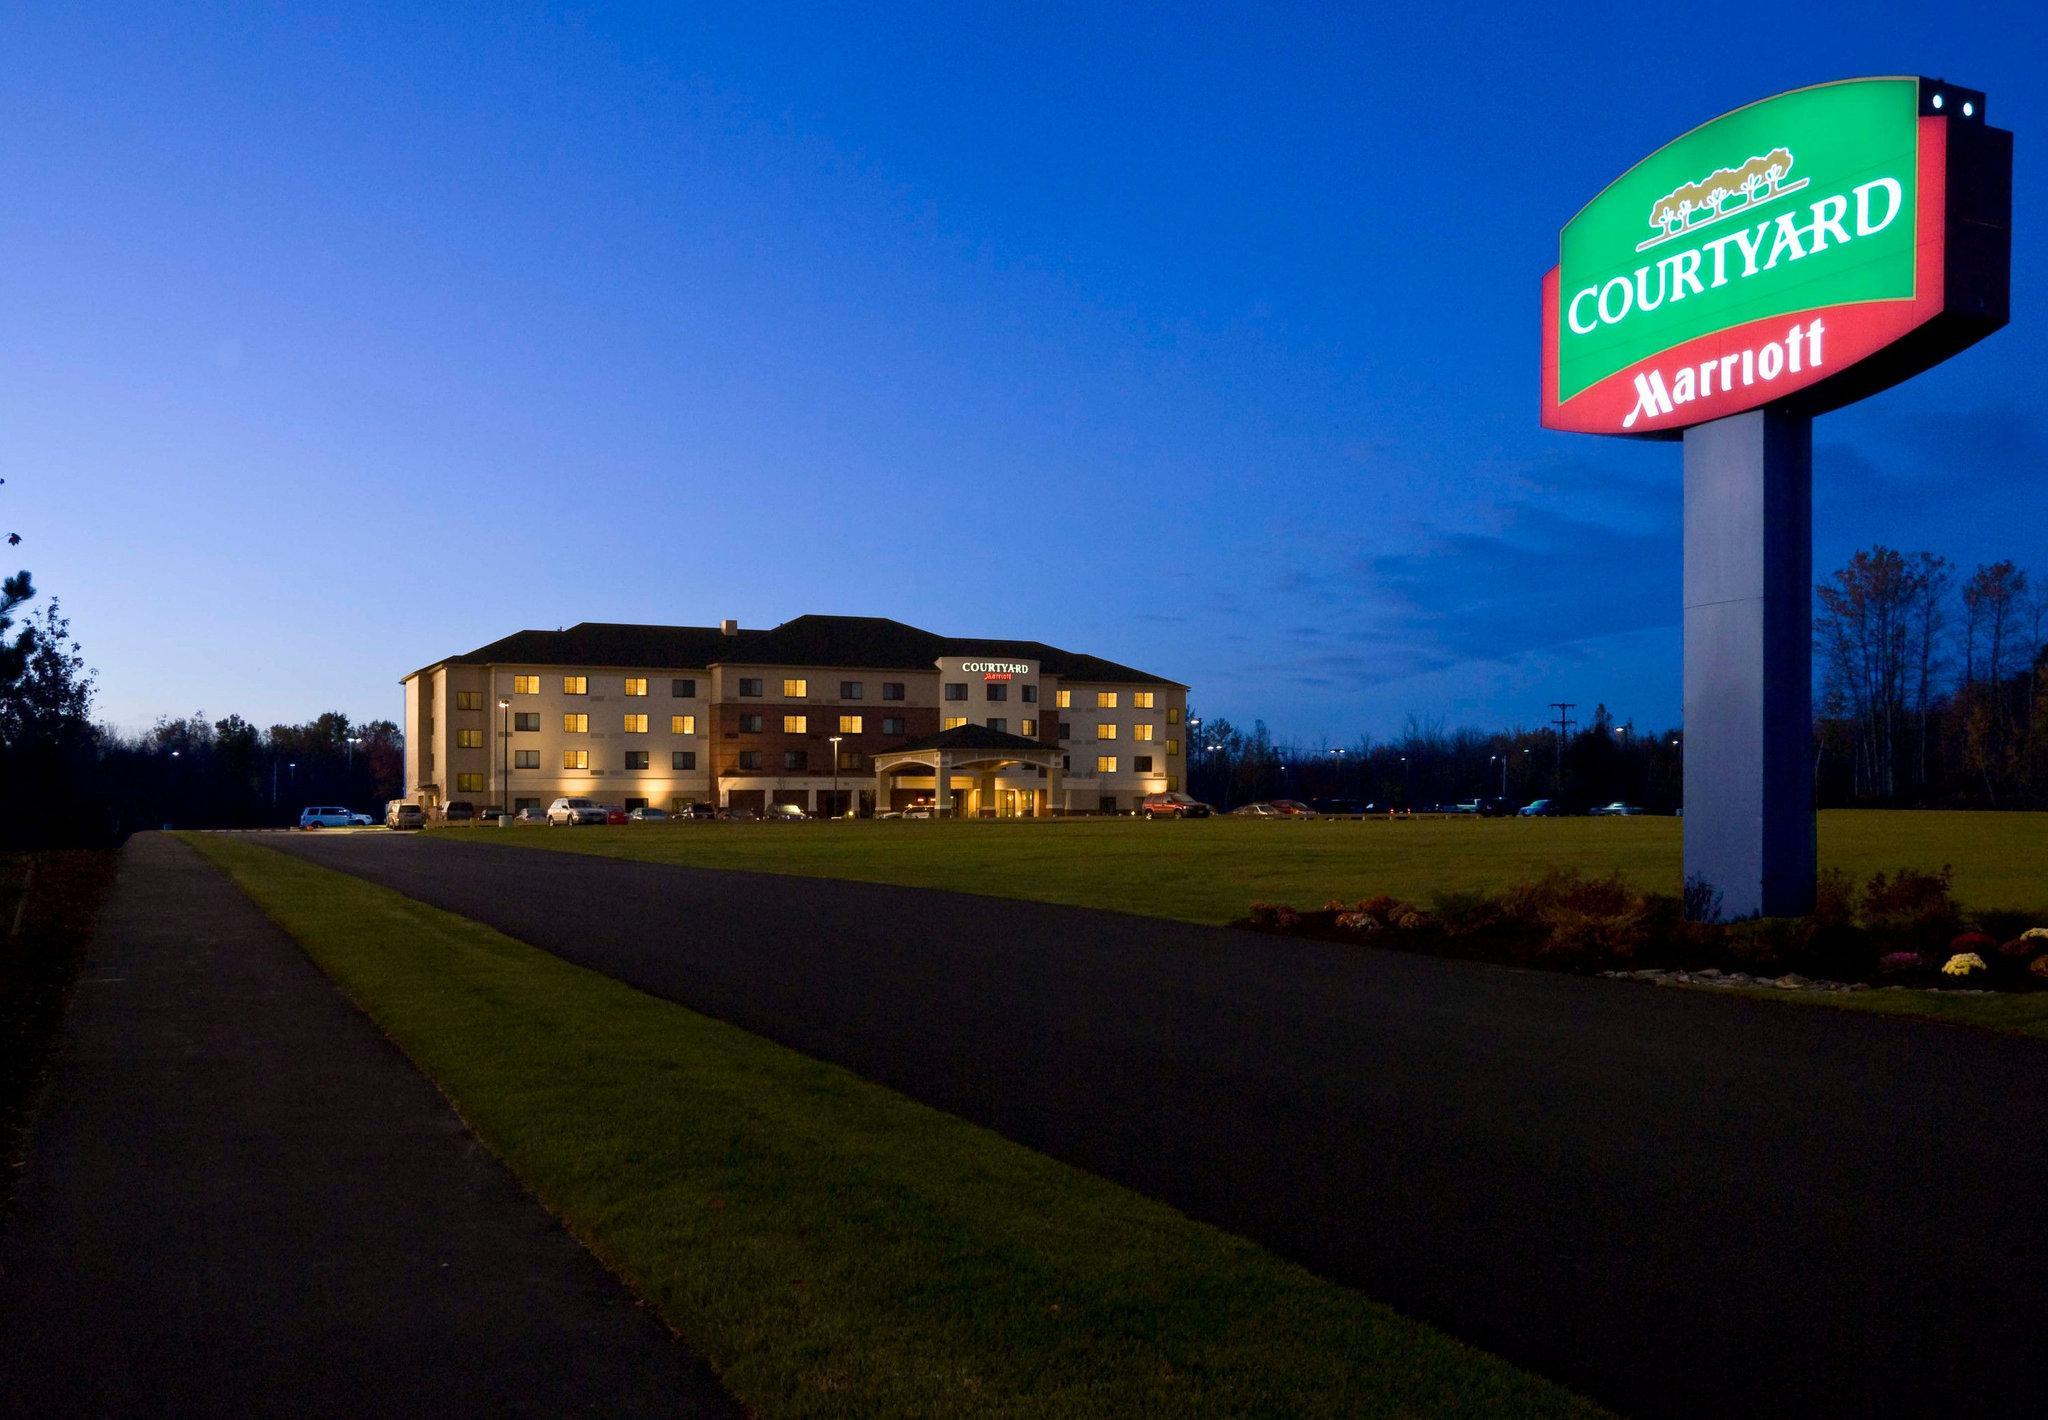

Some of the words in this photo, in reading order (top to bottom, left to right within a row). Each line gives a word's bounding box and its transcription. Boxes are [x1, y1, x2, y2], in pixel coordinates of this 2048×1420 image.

[1567, 177, 1902, 334] COURTYARD
[1622, 318, 1825, 428] Marriott
[962, 662, 1029, 674] COURTYARD
